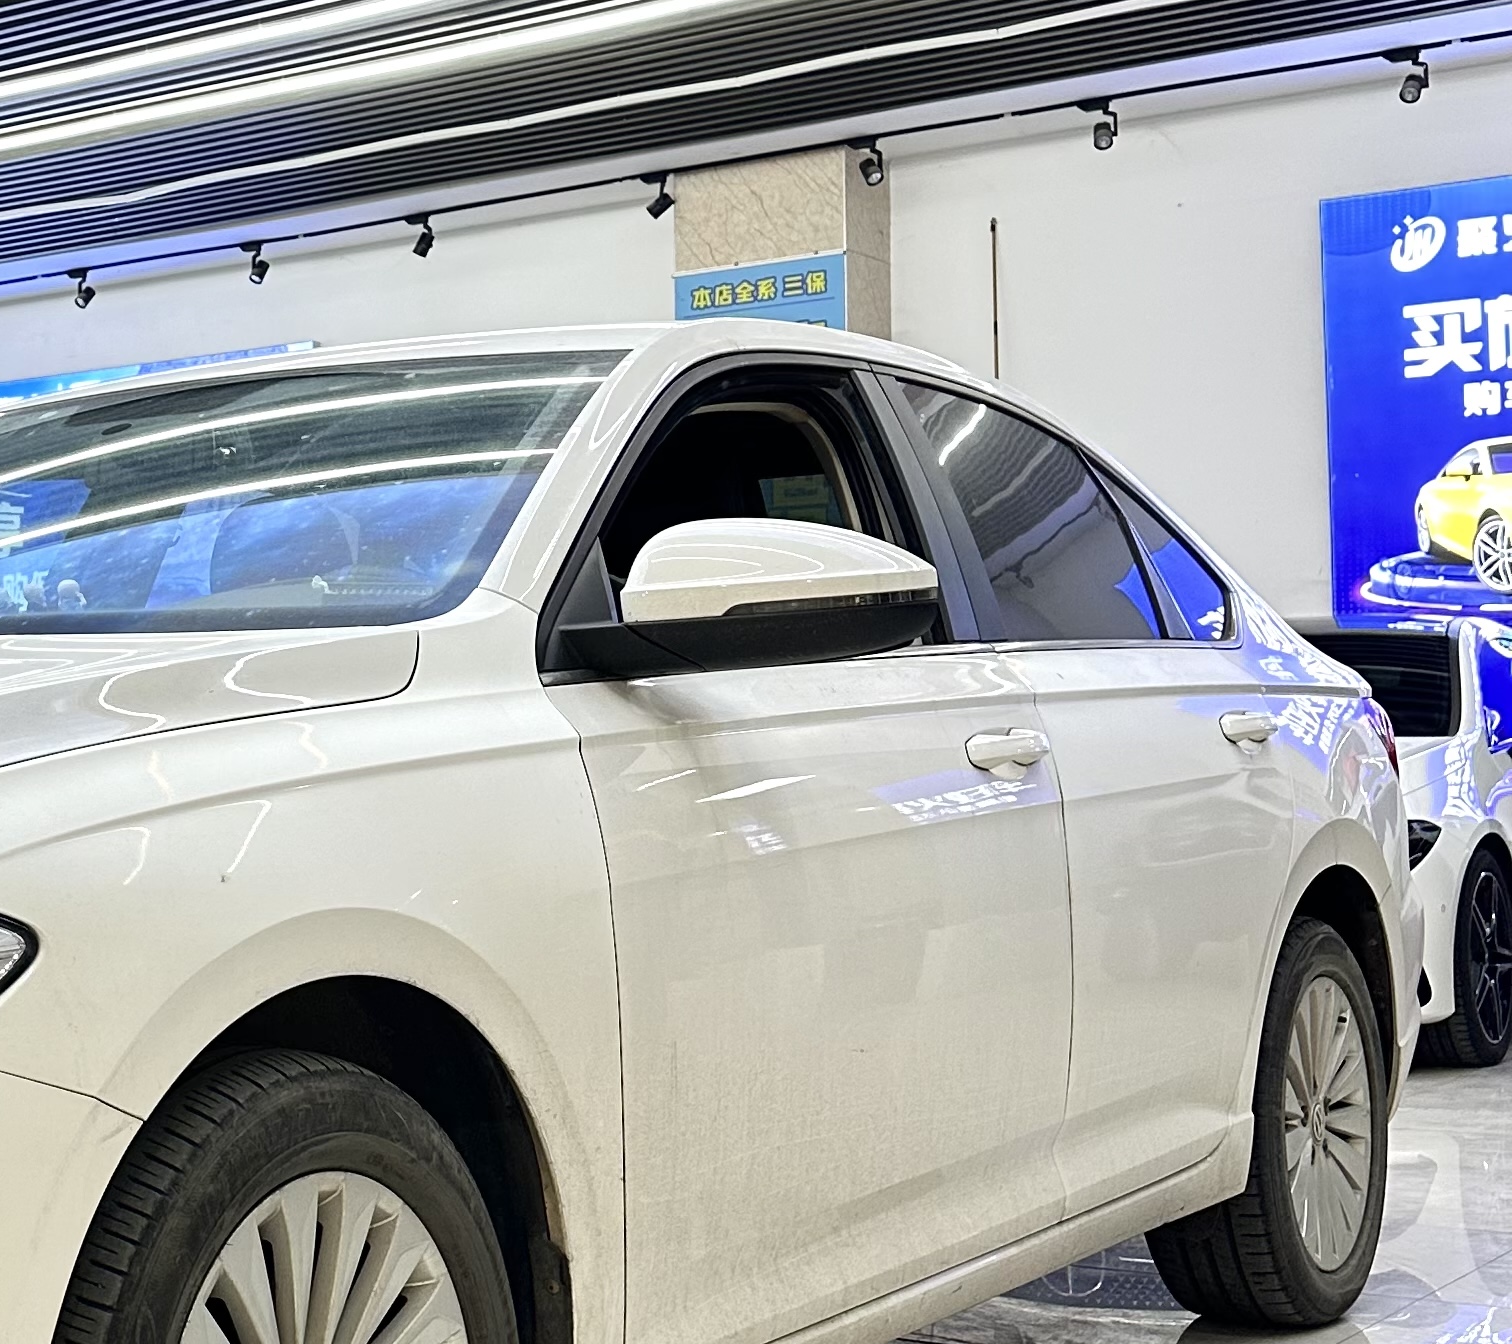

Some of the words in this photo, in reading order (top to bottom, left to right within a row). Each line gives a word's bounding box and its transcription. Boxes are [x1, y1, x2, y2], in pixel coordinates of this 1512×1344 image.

[691, 277, 777, 310] 本店全系
[783, 270, 827, 297] 三保
[1463, 380, 1512, 418] 购
